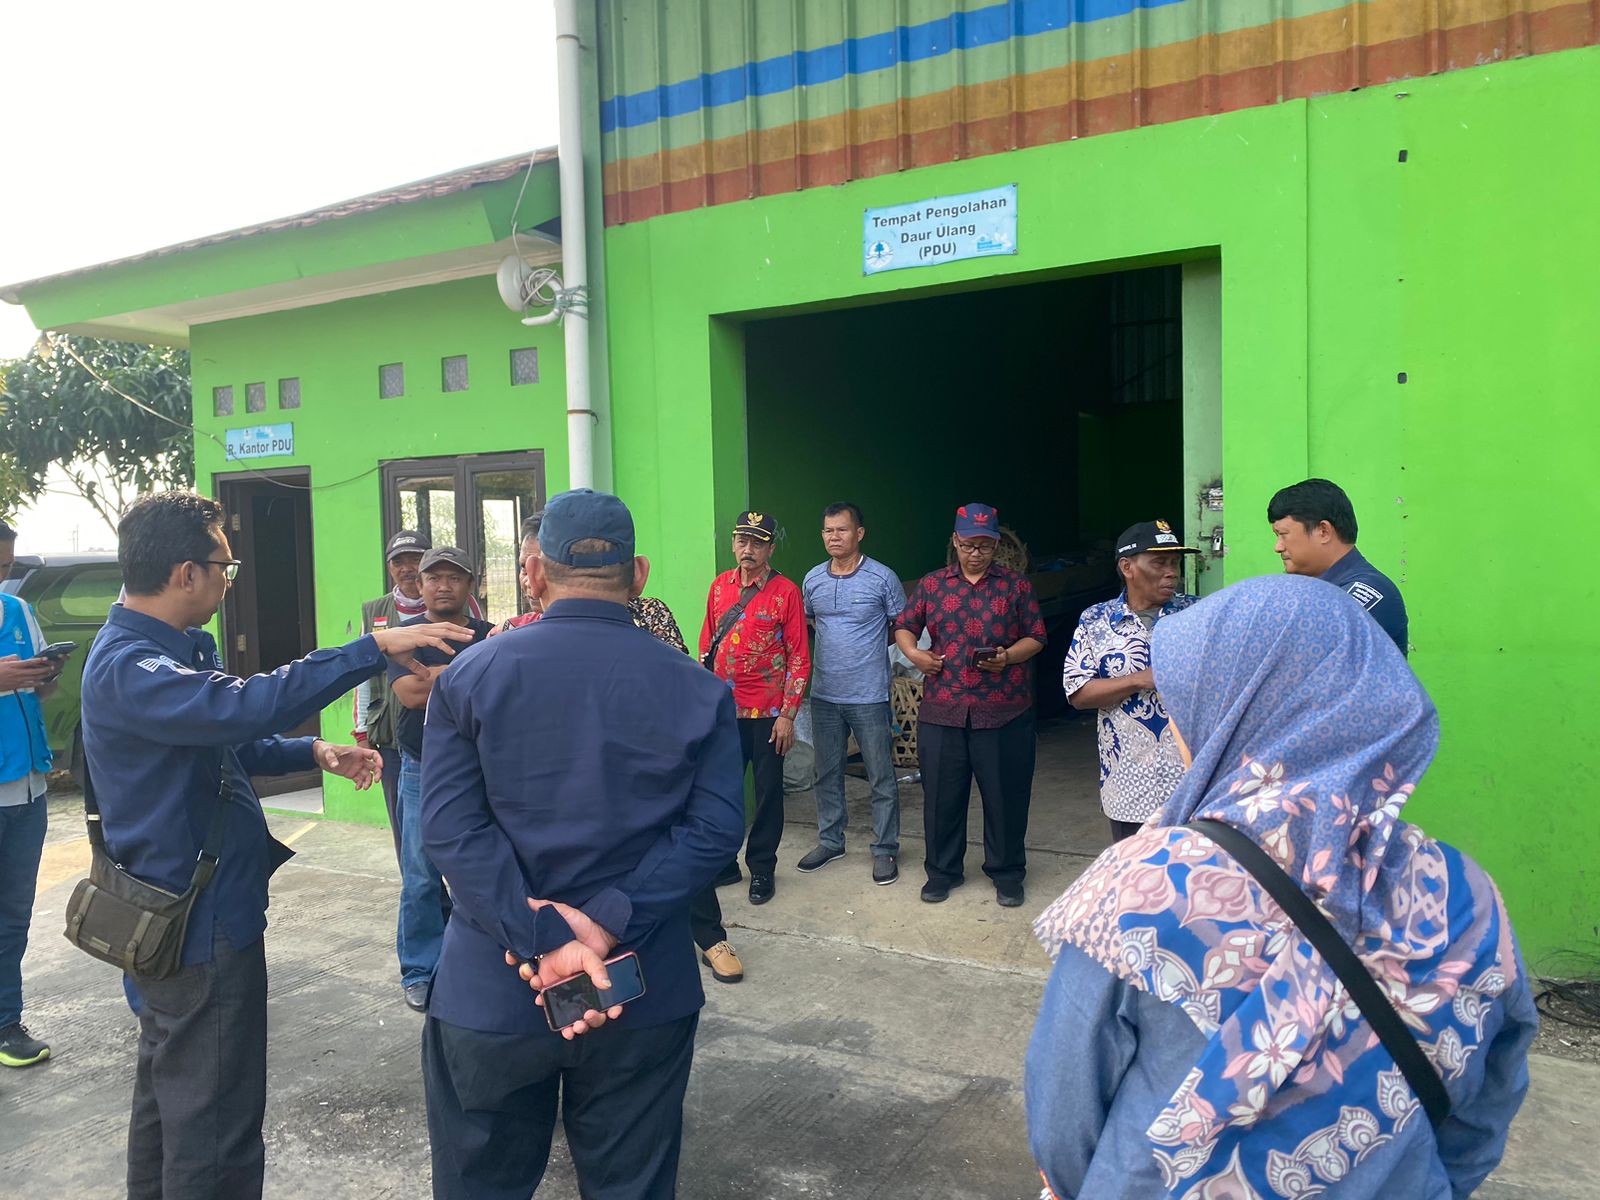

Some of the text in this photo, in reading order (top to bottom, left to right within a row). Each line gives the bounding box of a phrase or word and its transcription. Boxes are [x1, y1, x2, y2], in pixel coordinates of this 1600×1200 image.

[872, 198, 1007, 228] Tempat Pengolahan
[901, 224, 976, 244] Daur Ulang
[919, 242, 957, 260] (PDU)
[228, 439, 291, 455] R. Kantor PDU
